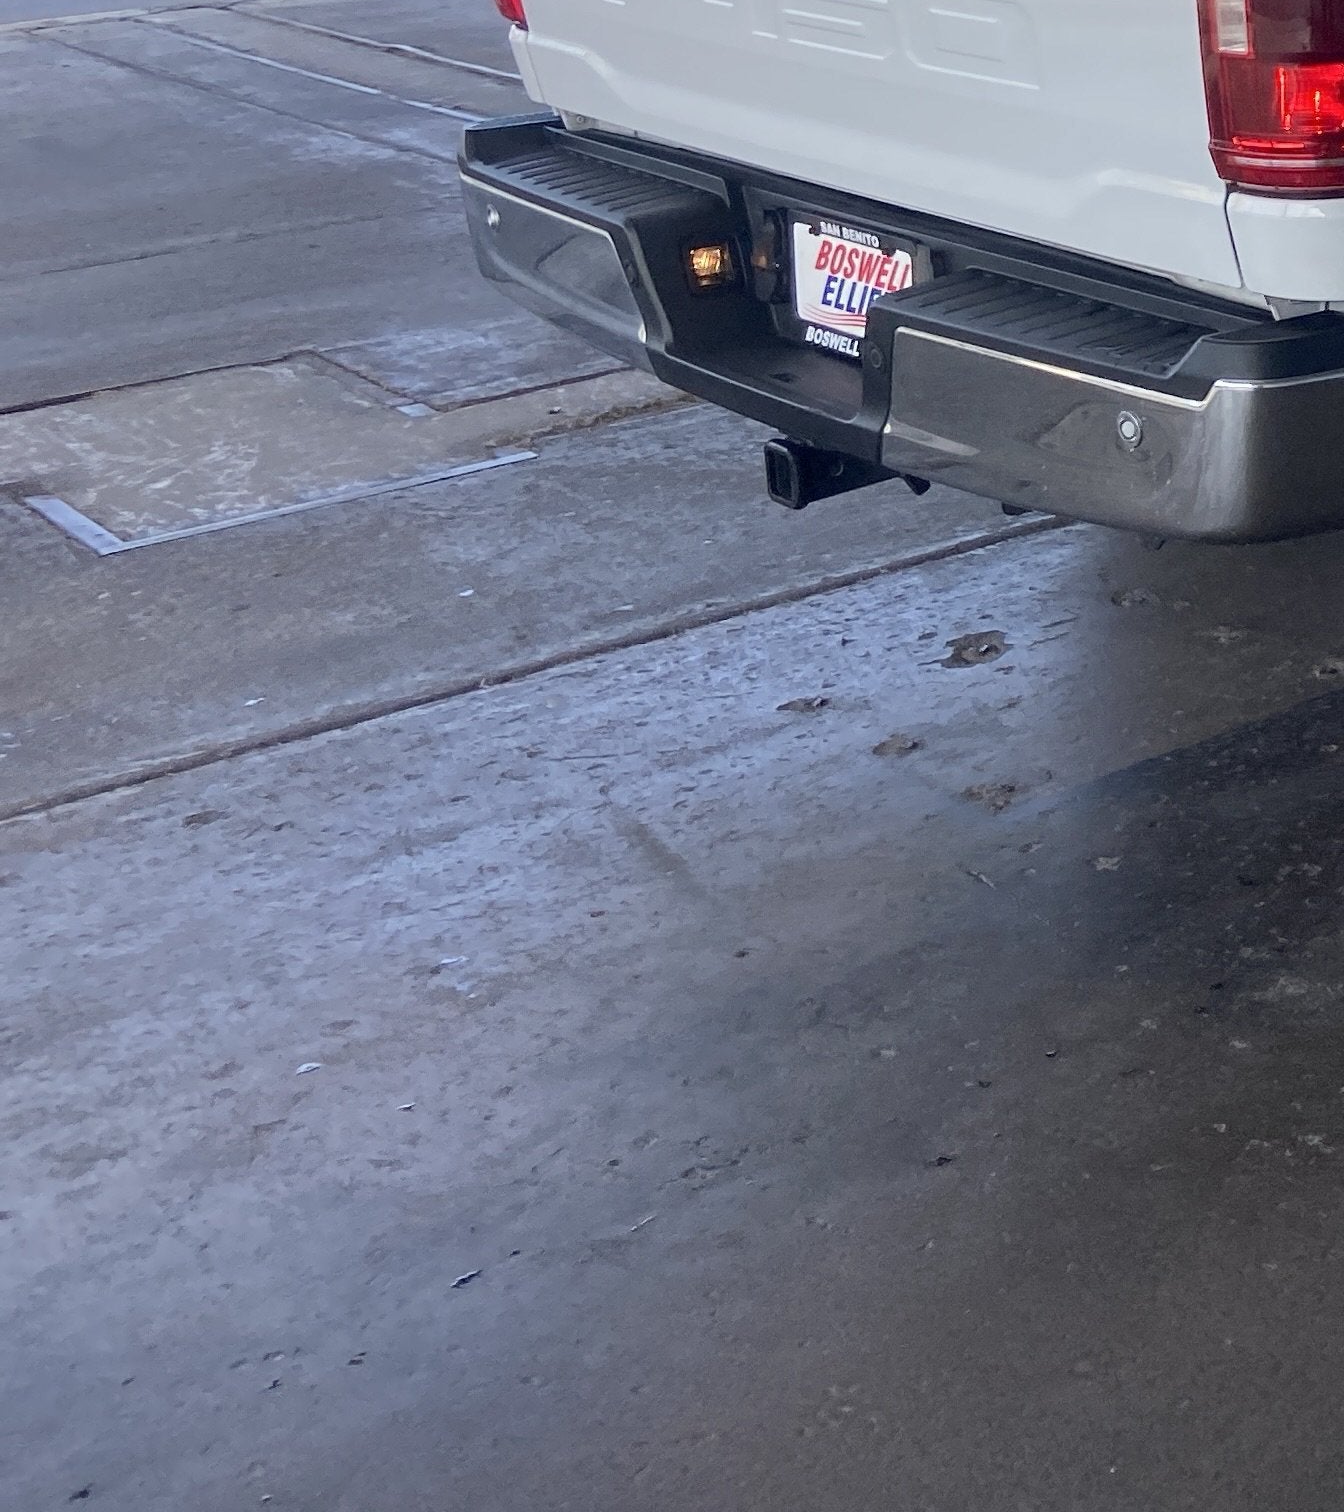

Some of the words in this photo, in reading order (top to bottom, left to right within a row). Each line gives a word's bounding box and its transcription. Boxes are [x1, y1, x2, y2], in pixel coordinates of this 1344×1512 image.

[819, 221, 841, 237] SAN
[842, 227, 880, 248] BENITO
[804, 326, 860, 357] BOSWELL
